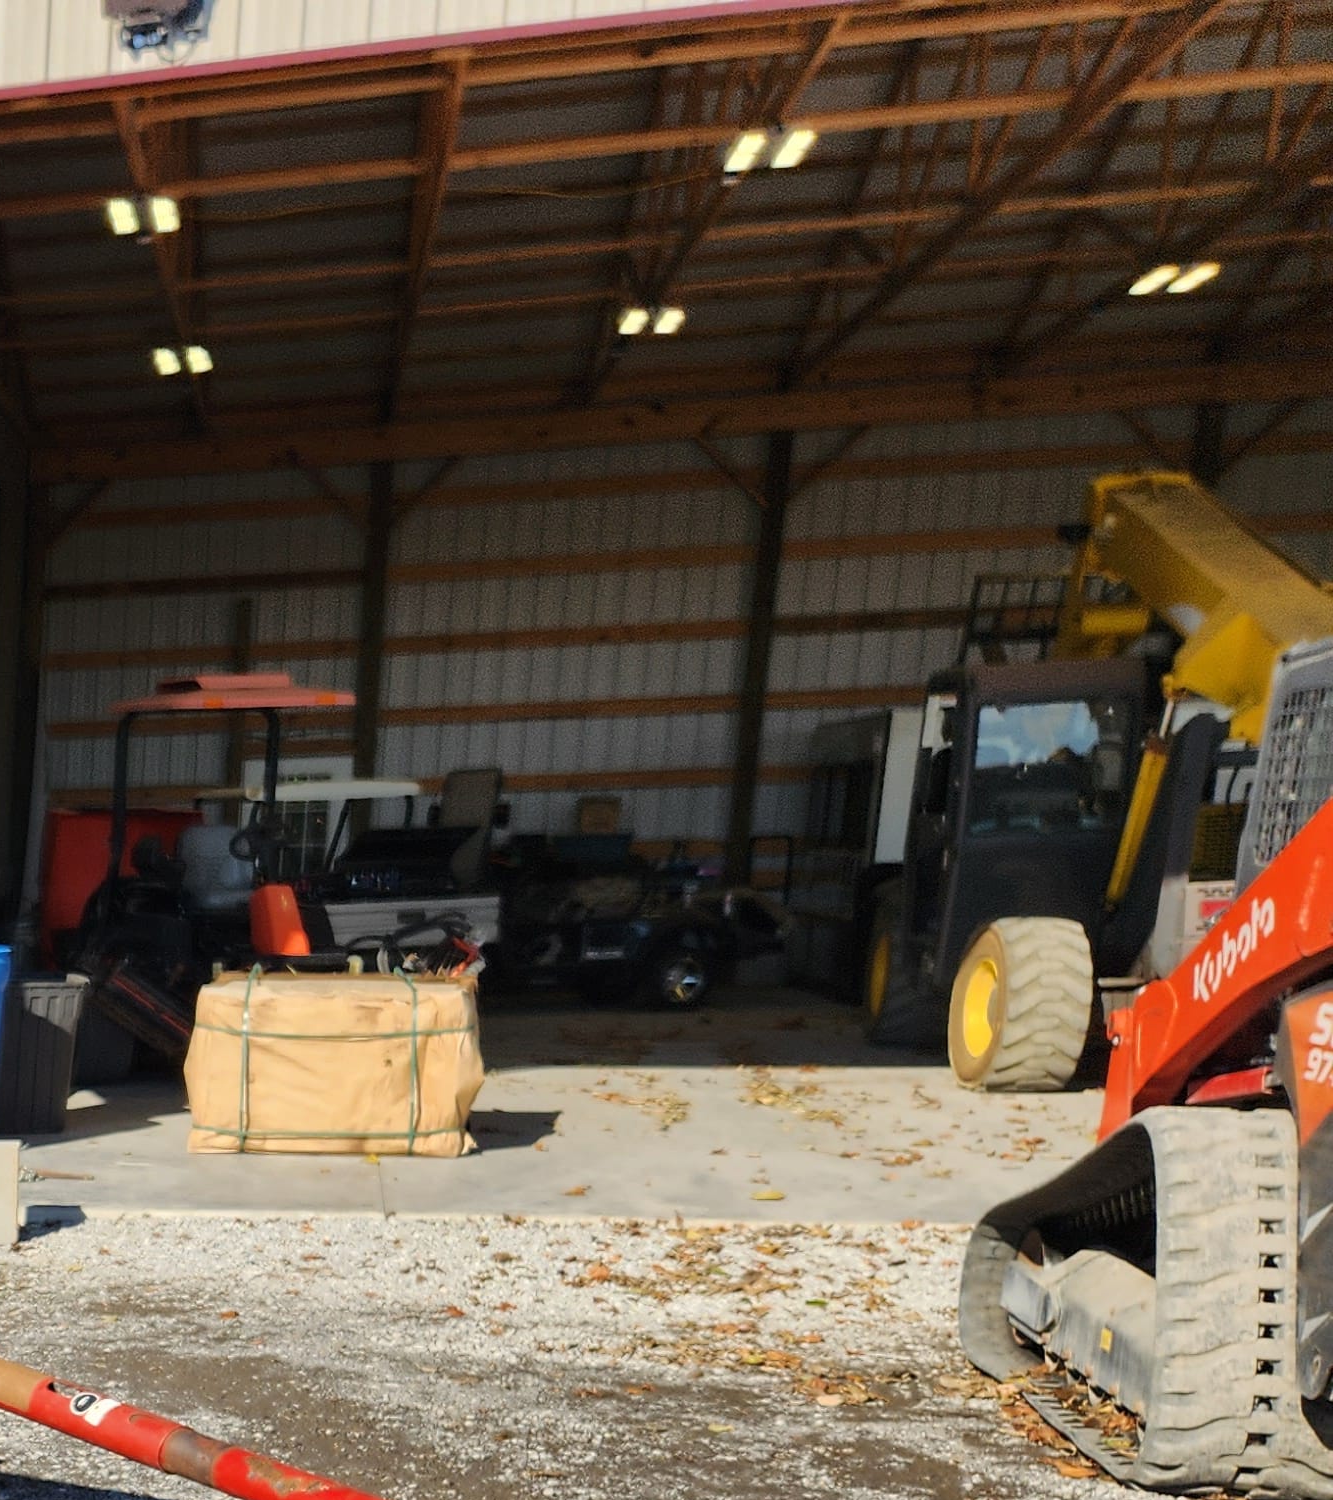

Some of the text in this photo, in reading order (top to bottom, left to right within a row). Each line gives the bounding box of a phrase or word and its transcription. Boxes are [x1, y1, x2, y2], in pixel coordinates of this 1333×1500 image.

[1193, 897, 1275, 1003] Kubota
[1309, 1002, 1333, 1046] S
[1303, 1047, 1333, 1087] 97
